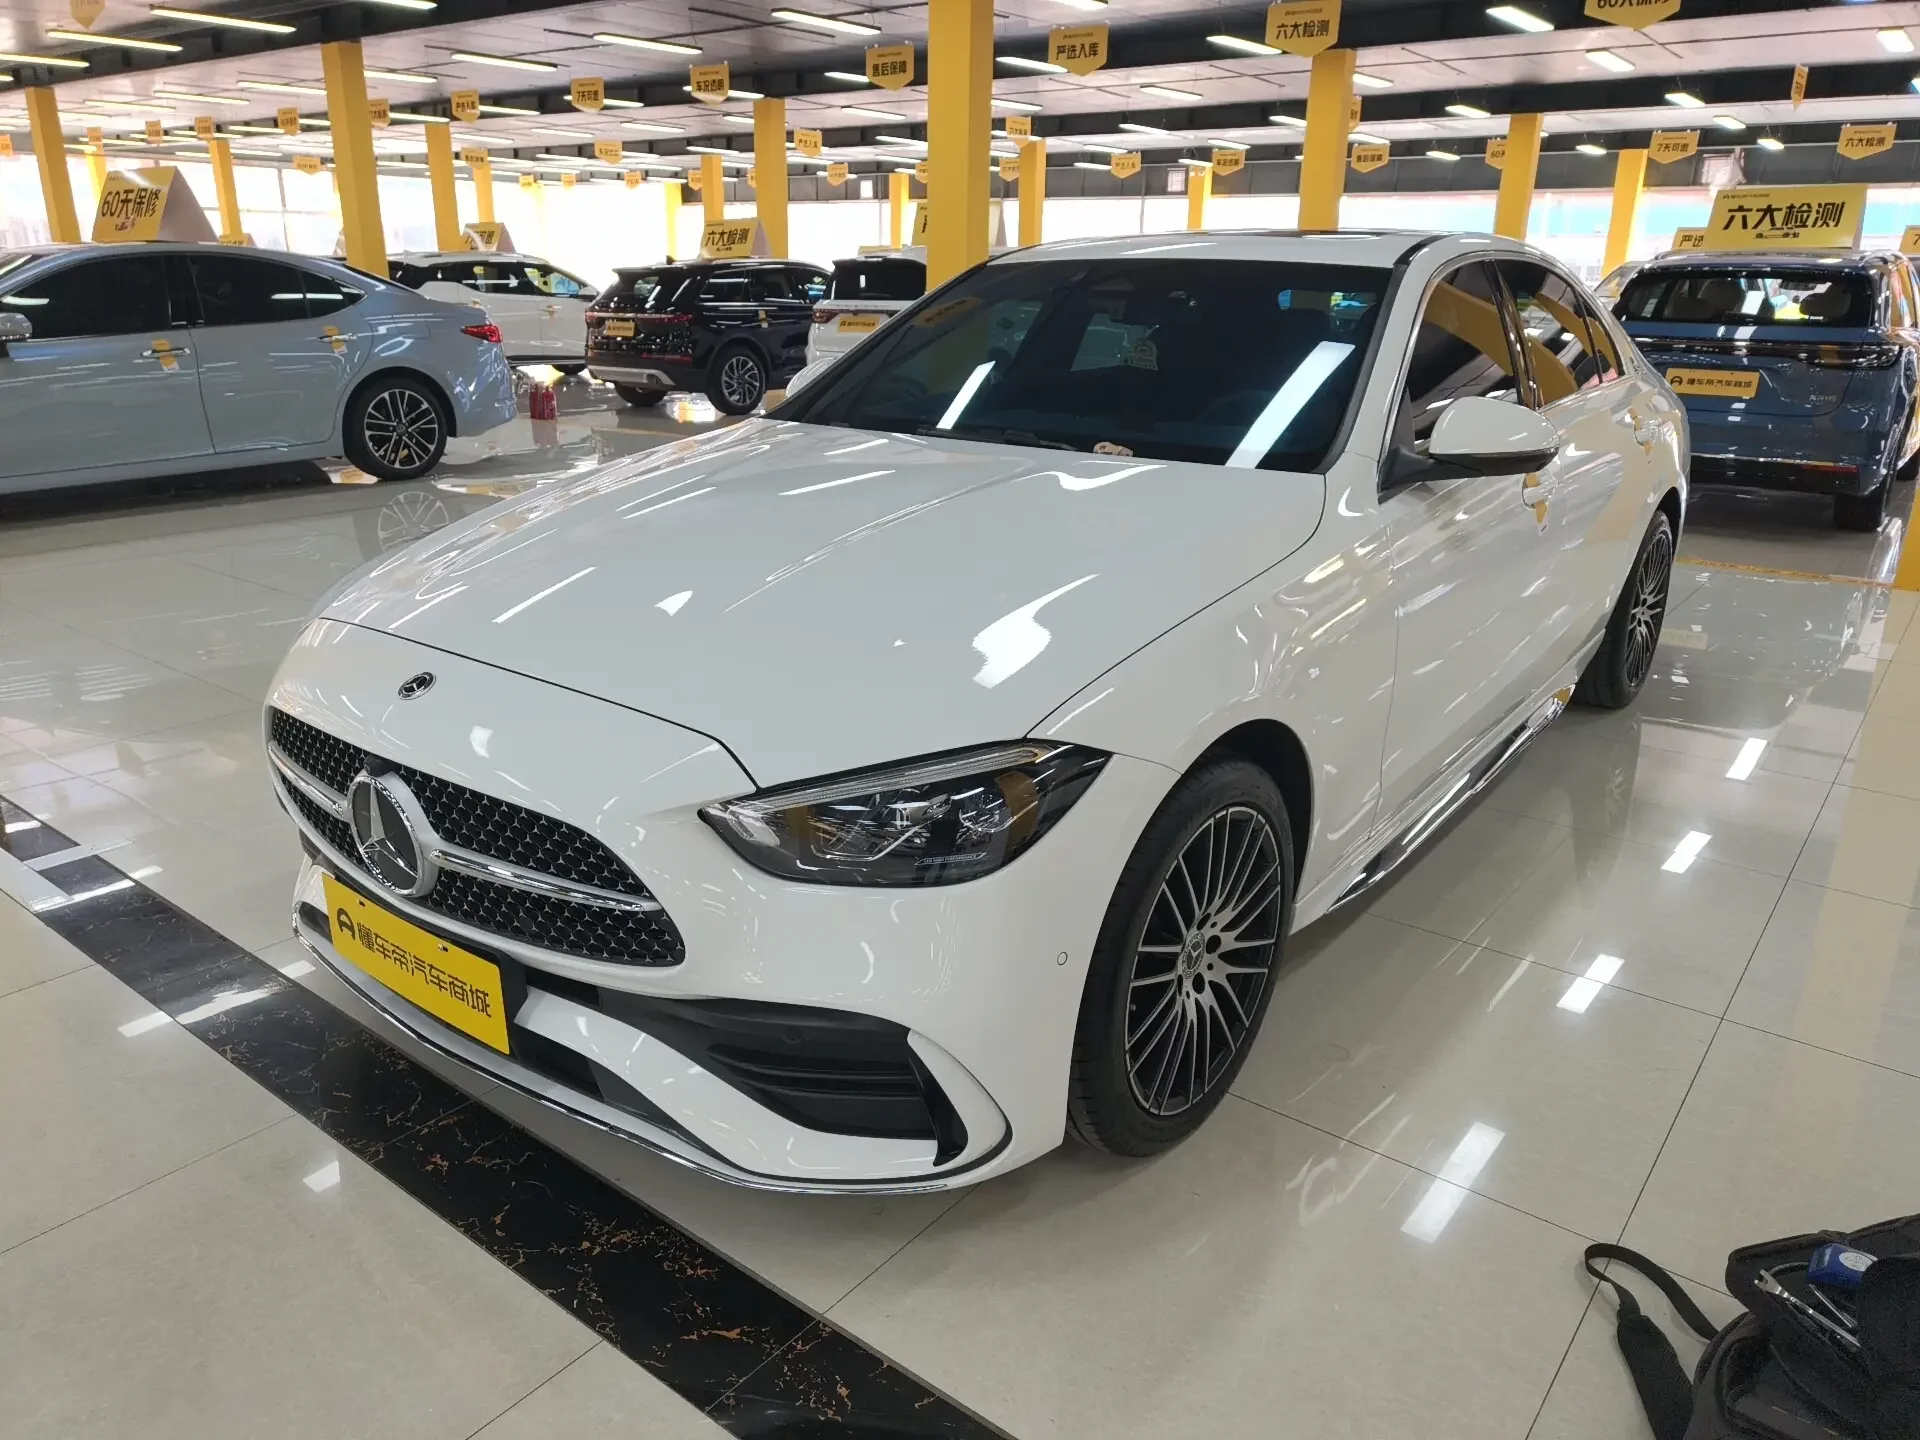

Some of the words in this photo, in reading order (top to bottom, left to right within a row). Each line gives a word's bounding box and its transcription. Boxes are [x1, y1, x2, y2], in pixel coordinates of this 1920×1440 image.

[1276, 19, 1330, 40] 六大检测
[1056, 43, 1100, 60] 严选入库
[872, 61, 907, 77] 售后保障
[696, 79, 724, 93] 车况透明
[576, 90, 599, 102] 7天可退
[1657, 143, 1689, 153] 7天可退
[1845, 136, 1886, 148] 六大检测
[101, 188, 164, 219] 60天保修
[1722, 201, 1846, 231] 六大检测
[705, 228, 750, 246] 六大检测
[357, 921, 491, 1018] 懂车帝汽车商城
